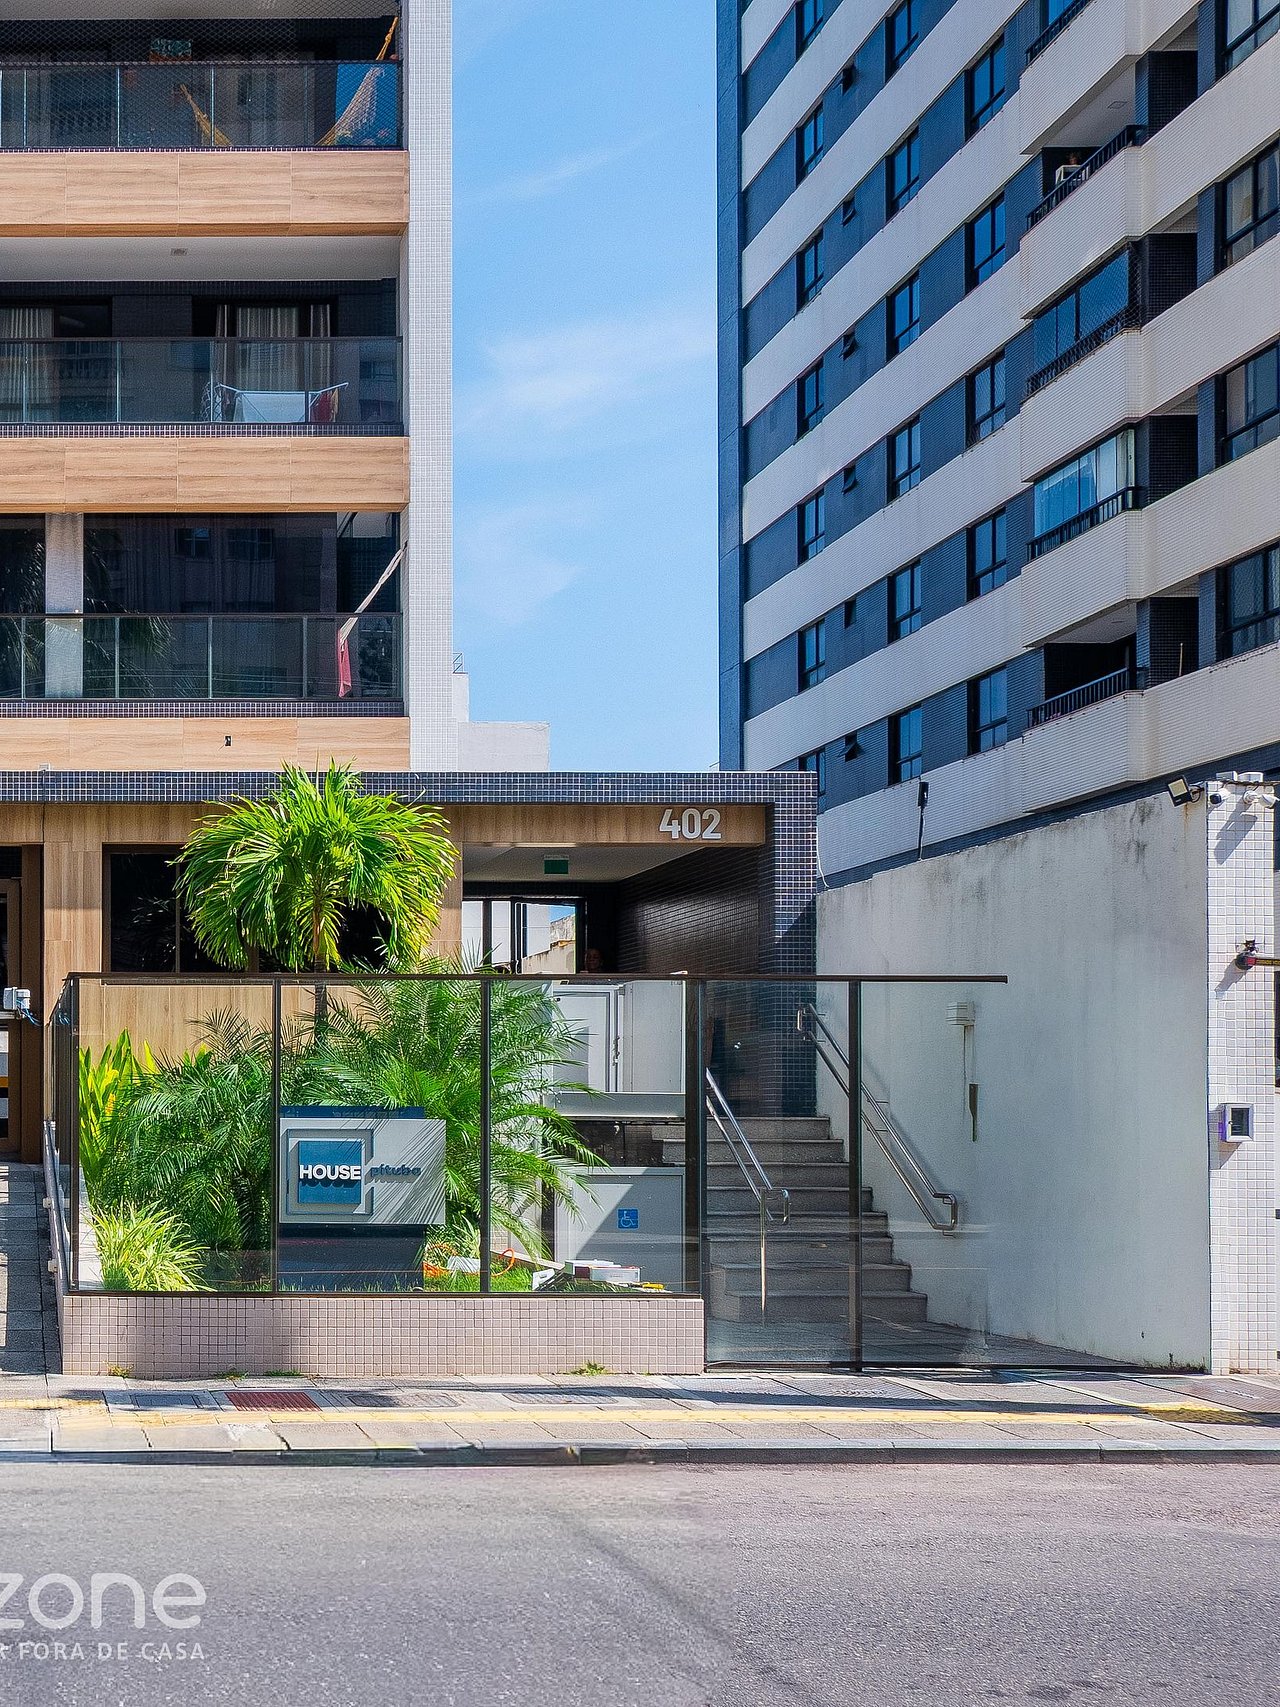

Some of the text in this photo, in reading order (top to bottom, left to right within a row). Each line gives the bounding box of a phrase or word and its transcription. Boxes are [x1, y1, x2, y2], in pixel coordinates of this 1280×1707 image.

[660, 808, 721, 839] 402
[299, 1163, 422, 1180] HOUSE pituba
